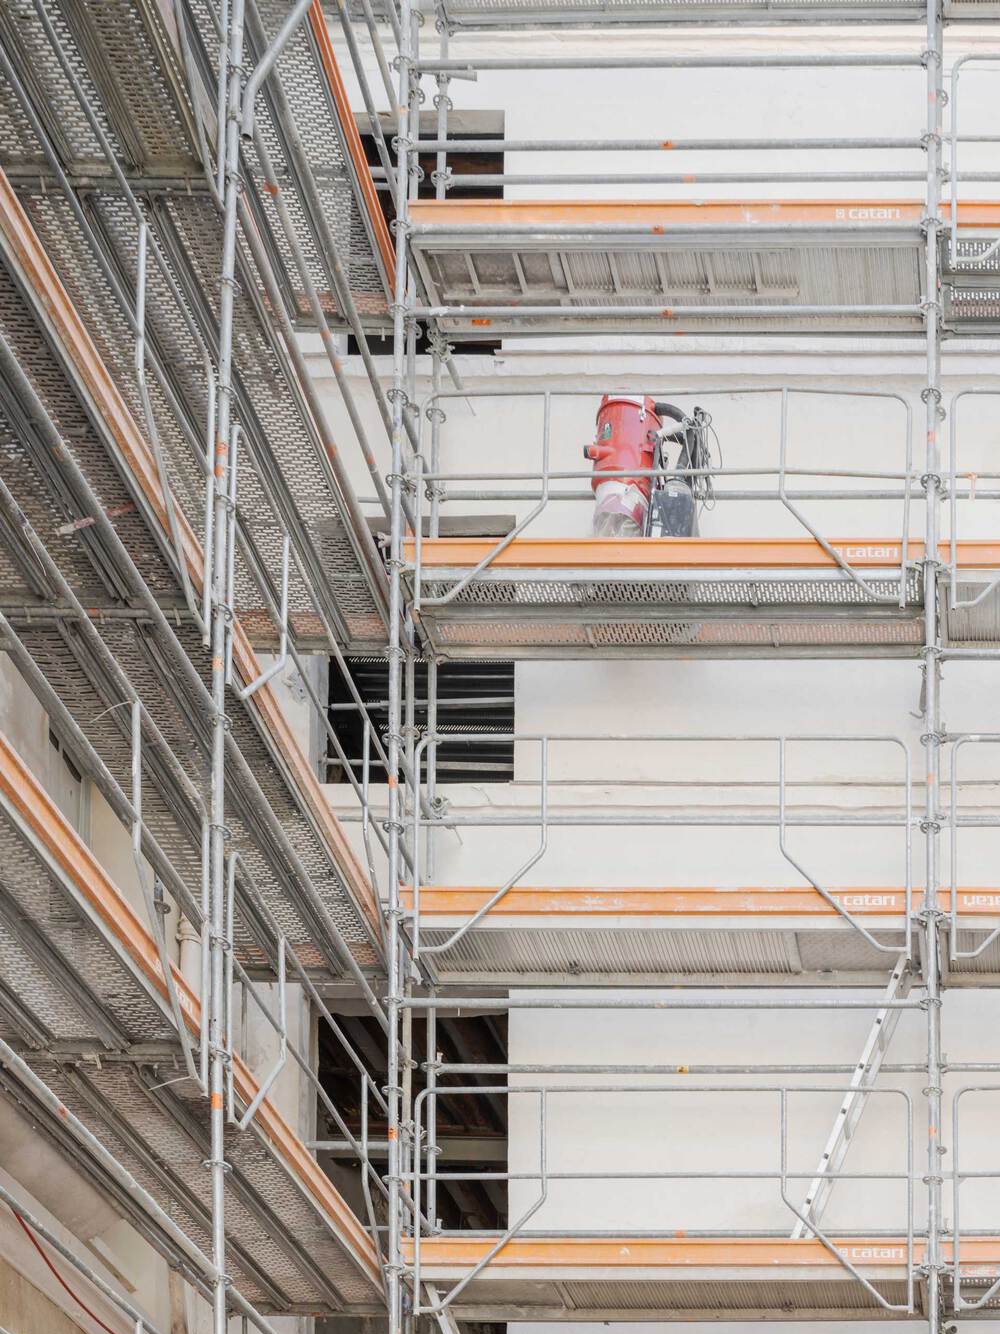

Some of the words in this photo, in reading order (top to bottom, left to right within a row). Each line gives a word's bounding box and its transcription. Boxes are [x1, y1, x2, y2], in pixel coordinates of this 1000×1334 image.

[849, 208, 900, 219] catari
[847, 547, 898, 558] catari
[844, 895, 895, 906] catari
[852, 1248, 903, 1258] catari
